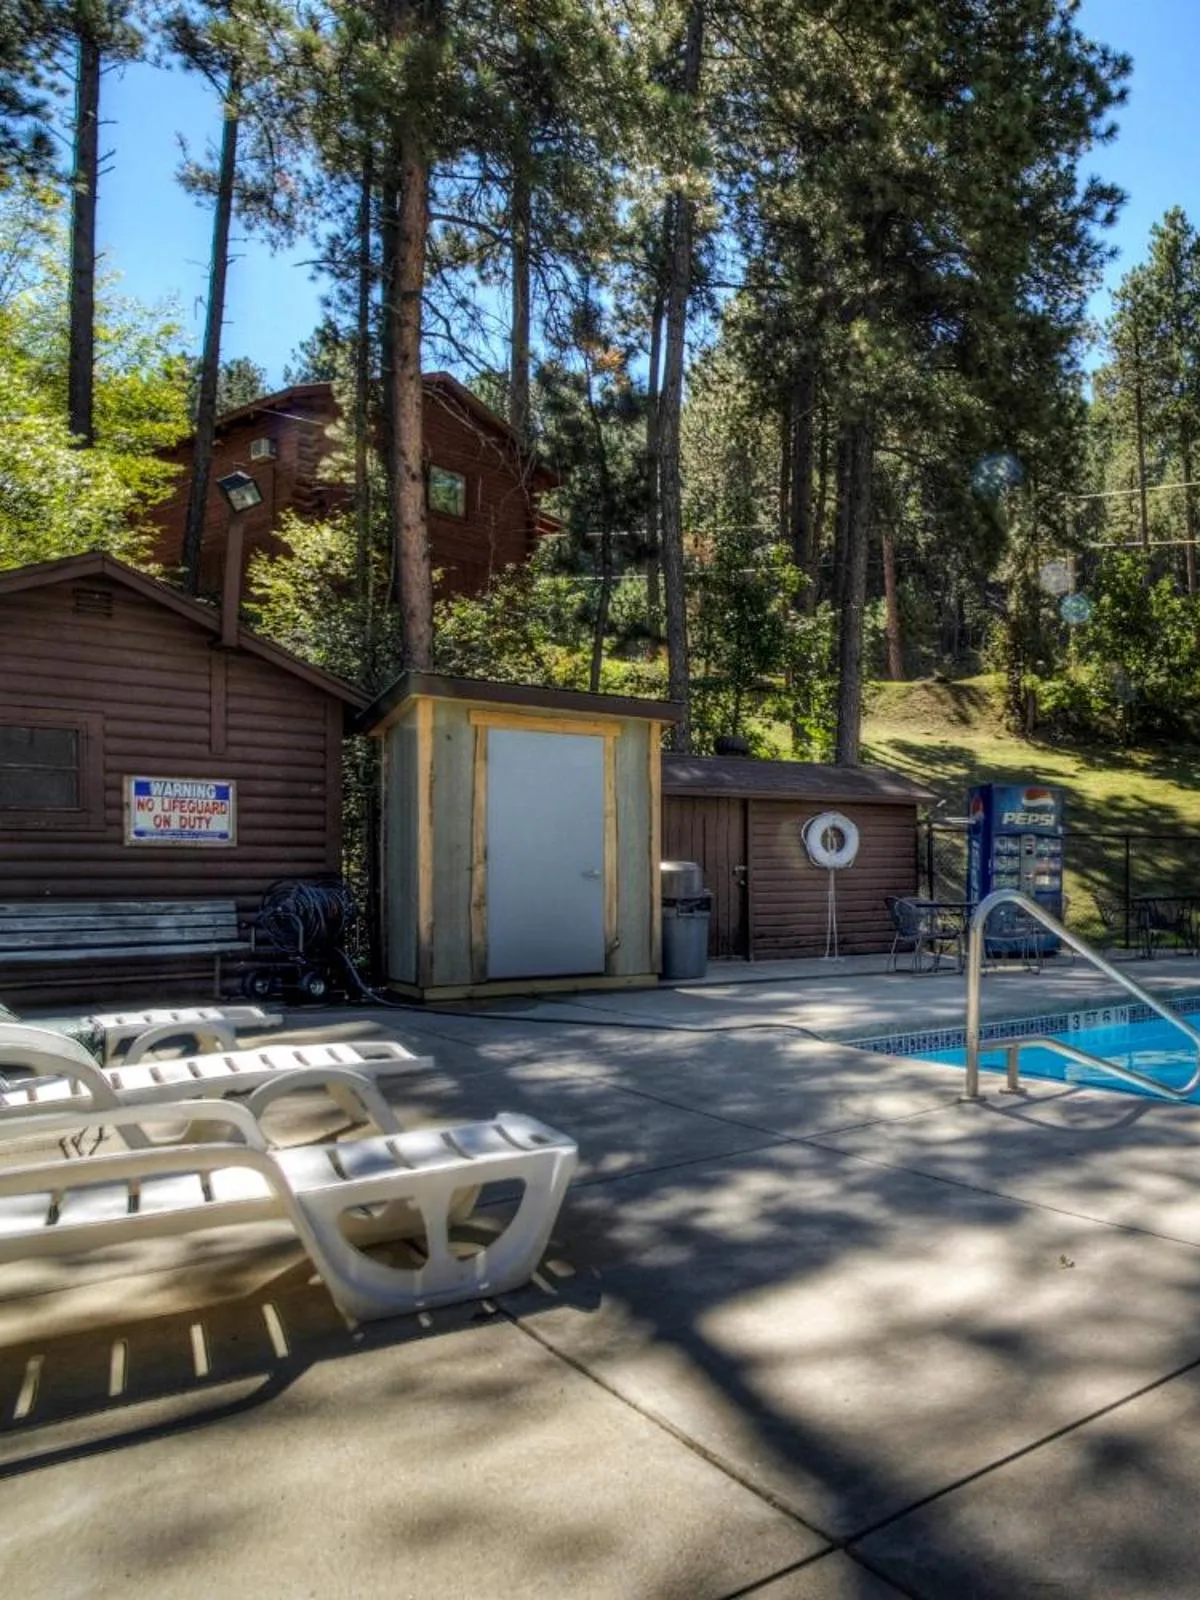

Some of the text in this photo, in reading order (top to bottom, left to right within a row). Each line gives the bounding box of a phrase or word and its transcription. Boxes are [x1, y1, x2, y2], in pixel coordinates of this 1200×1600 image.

[151, 781, 216, 799] WARNING
[137, 799, 227, 815] NO LIFEGUARD
[153, 815, 212, 829] ON DUTY
[1003, 812, 1056, 826] PEPSI
[1072, 1014, 1080, 1030] 3
[1085, 1011, 1099, 1026] FT
[1102, 1010, 1112, 1024] 6
